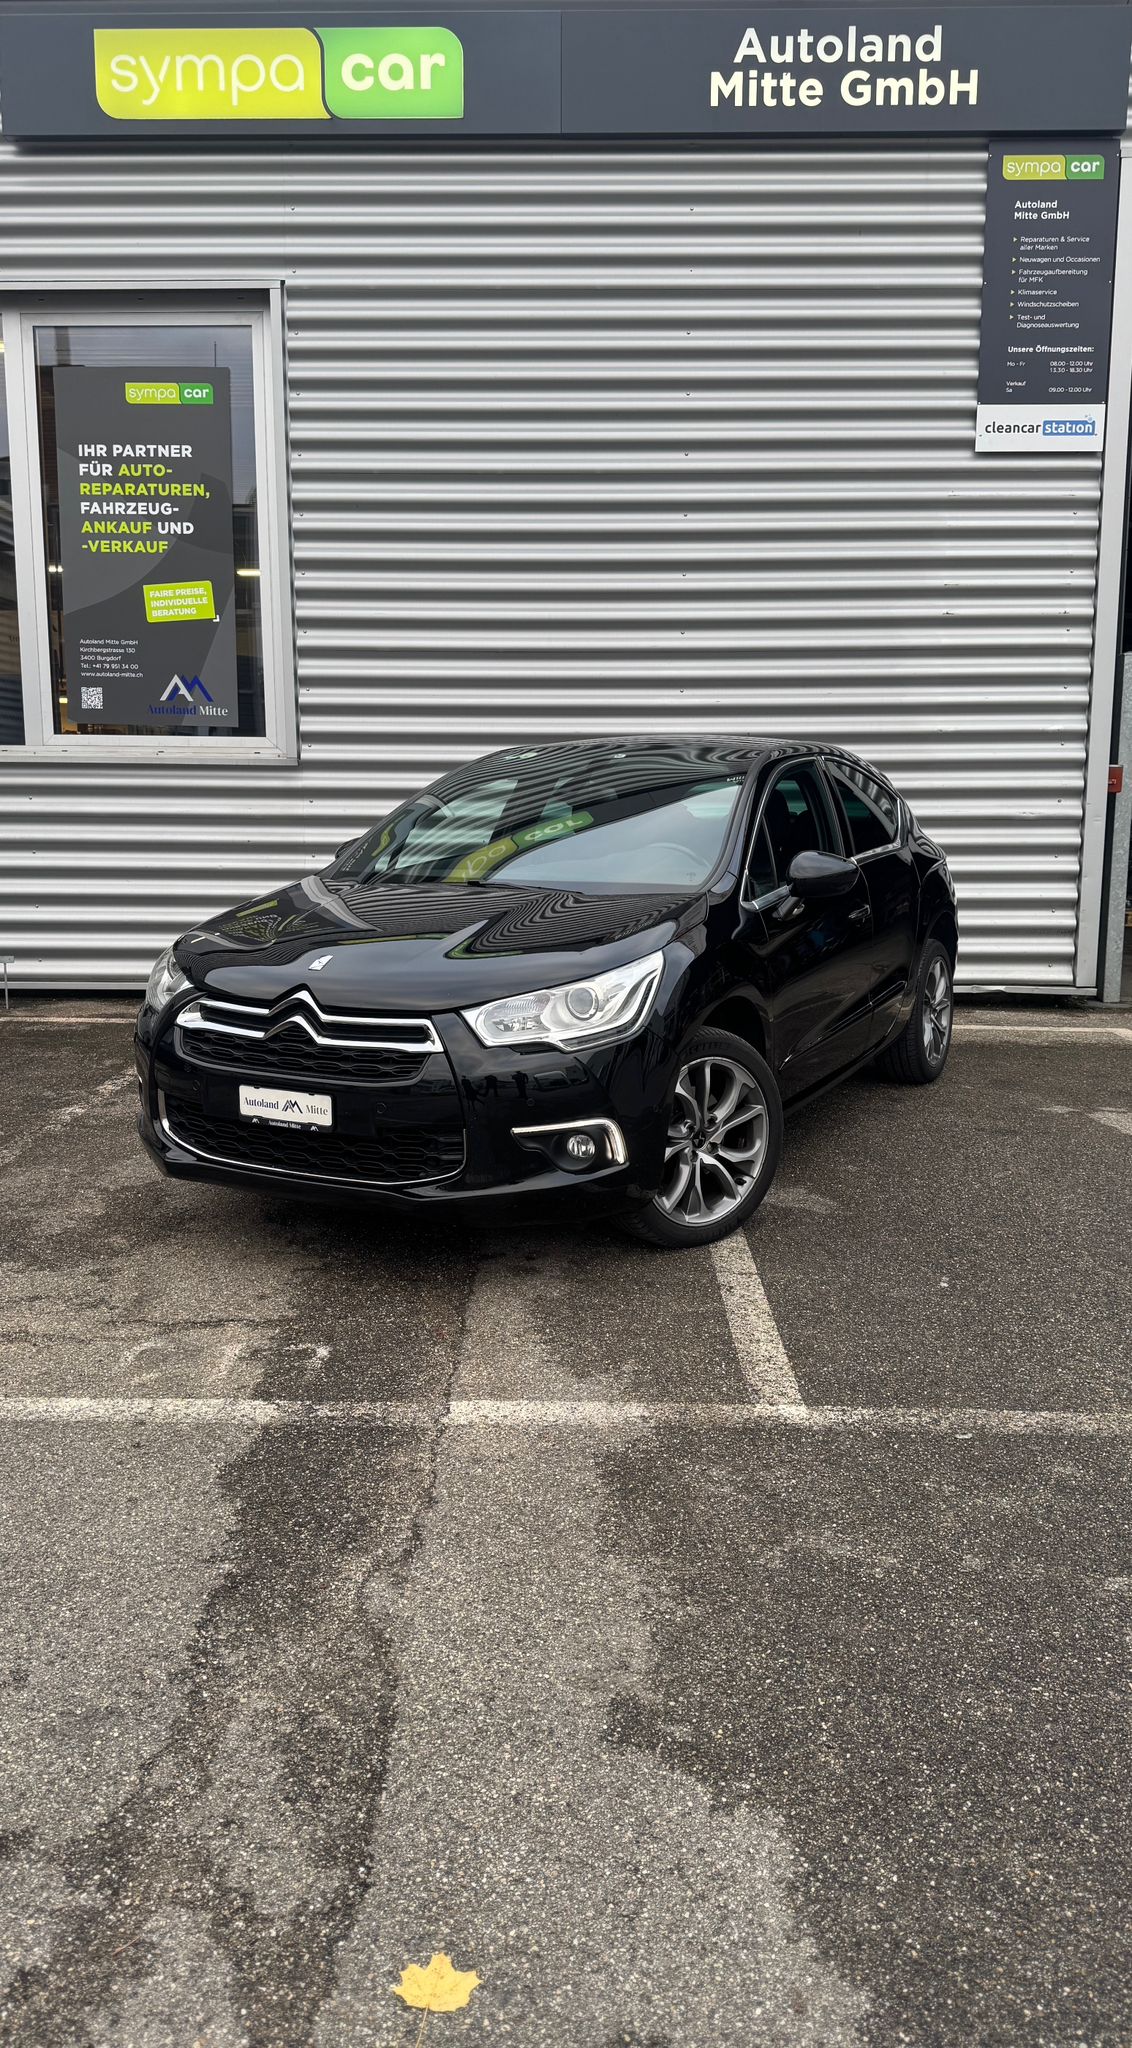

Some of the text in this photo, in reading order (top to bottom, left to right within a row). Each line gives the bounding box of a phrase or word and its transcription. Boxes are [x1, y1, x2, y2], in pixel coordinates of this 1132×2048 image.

[733, 25, 943, 64] Autoland
[110, 52, 445, 105] sympa car
[710, 69, 979, 107] Mitte GmbH
[1007, 161, 1100, 176] sympa car
[1014, 200, 1058, 208] Autoland
[1014, 212, 1038, 220] Mitte
[1036, 344, 1094, 354] Öffnungszeiten:
[129, 388, 209, 400] sympa car
[985, 421, 1092, 434] cleancar station
[78, 444, 192, 458] IHR PARTNER
[79, 461, 172, 477] FÜR AUTO-
[80, 483, 210, 498] REPARATUREN,
[80, 502, 179, 515] FAHRZEUG-
[81, 521, 194, 534] ANKAUF UND
[82, 540, 168, 553] -VERKAUF
[150, 588, 206, 598] FAIRE PREISE,
[151, 597, 208, 608] INDIVIDUELLE
[152, 608, 196, 617] BERATUNG
[148, 704, 228, 716] Autoland Mitte
[244, 1097, 279, 1110] Autoland
[306, 1104, 328, 1116] Mitte
